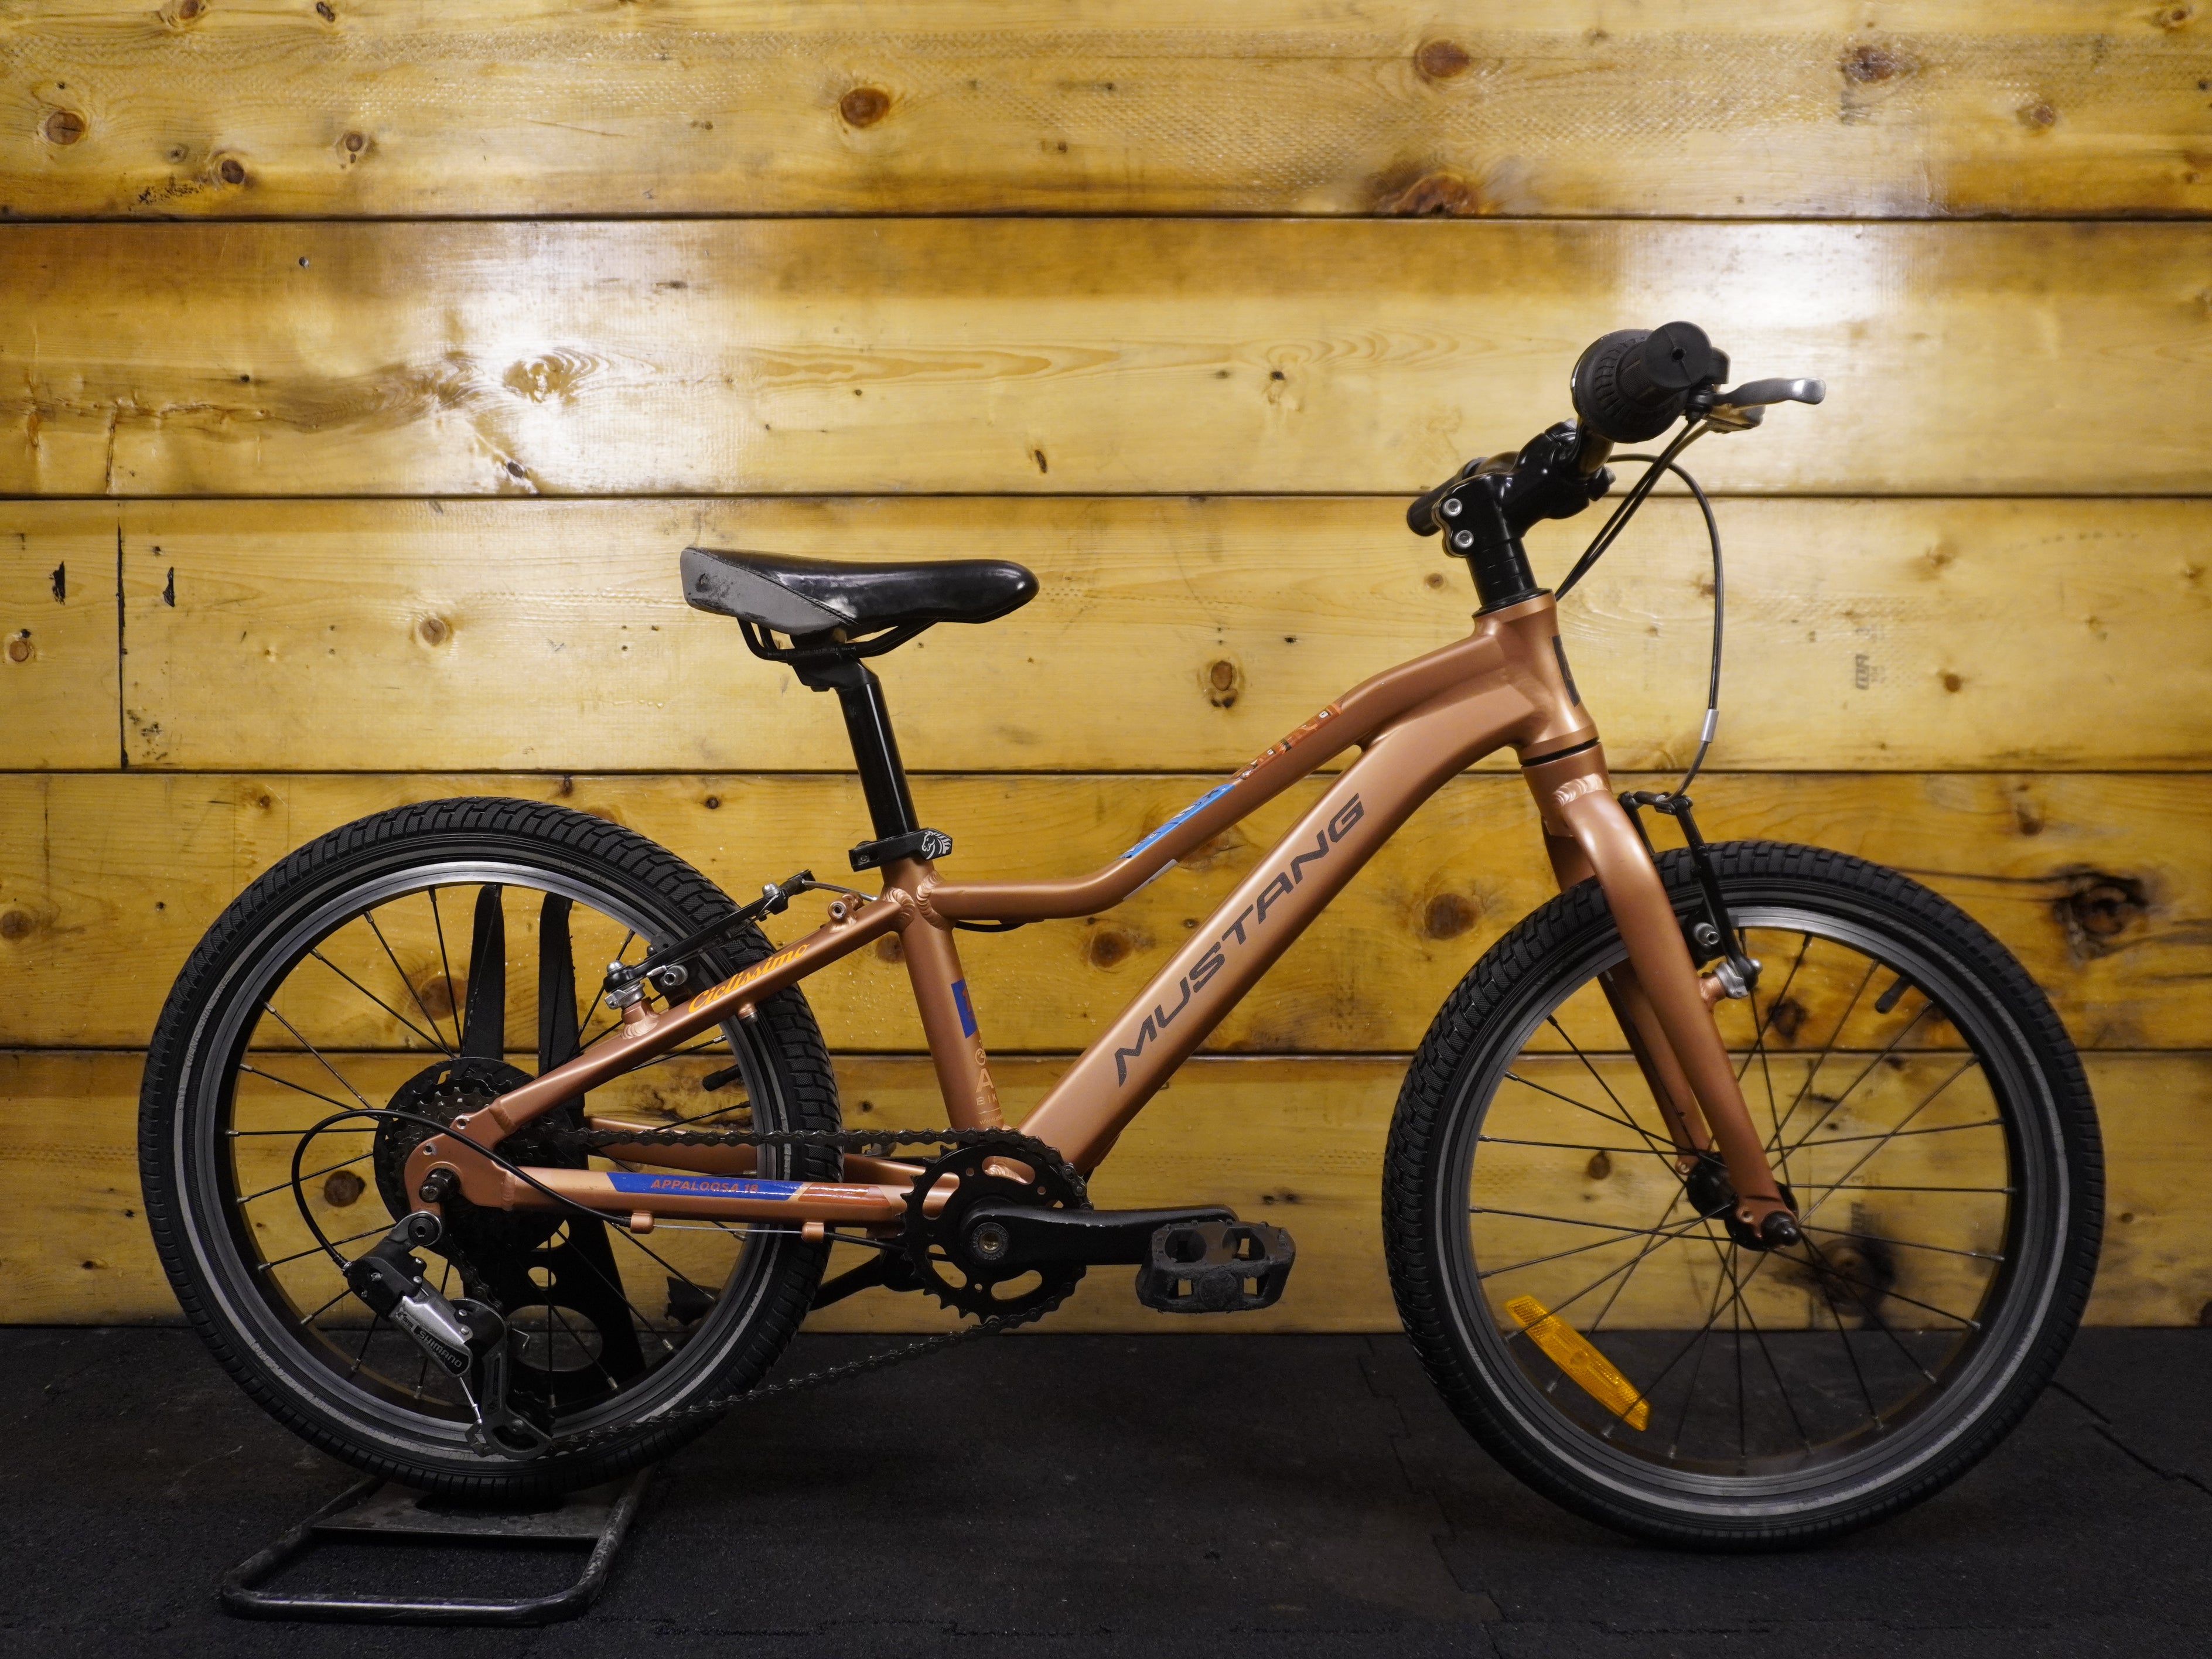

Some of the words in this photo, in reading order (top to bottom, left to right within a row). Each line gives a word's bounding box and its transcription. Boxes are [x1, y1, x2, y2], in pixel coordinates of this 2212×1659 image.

[1114, 793, 1365, 1088] MUSTANG
[688, 944, 811, 1013] Ciclissimo
[650, 1179, 739, 1192] APPALOOSA
[745, 1184, 759, 1192] 18
[418, 1330, 463, 1368] SHIMANO
